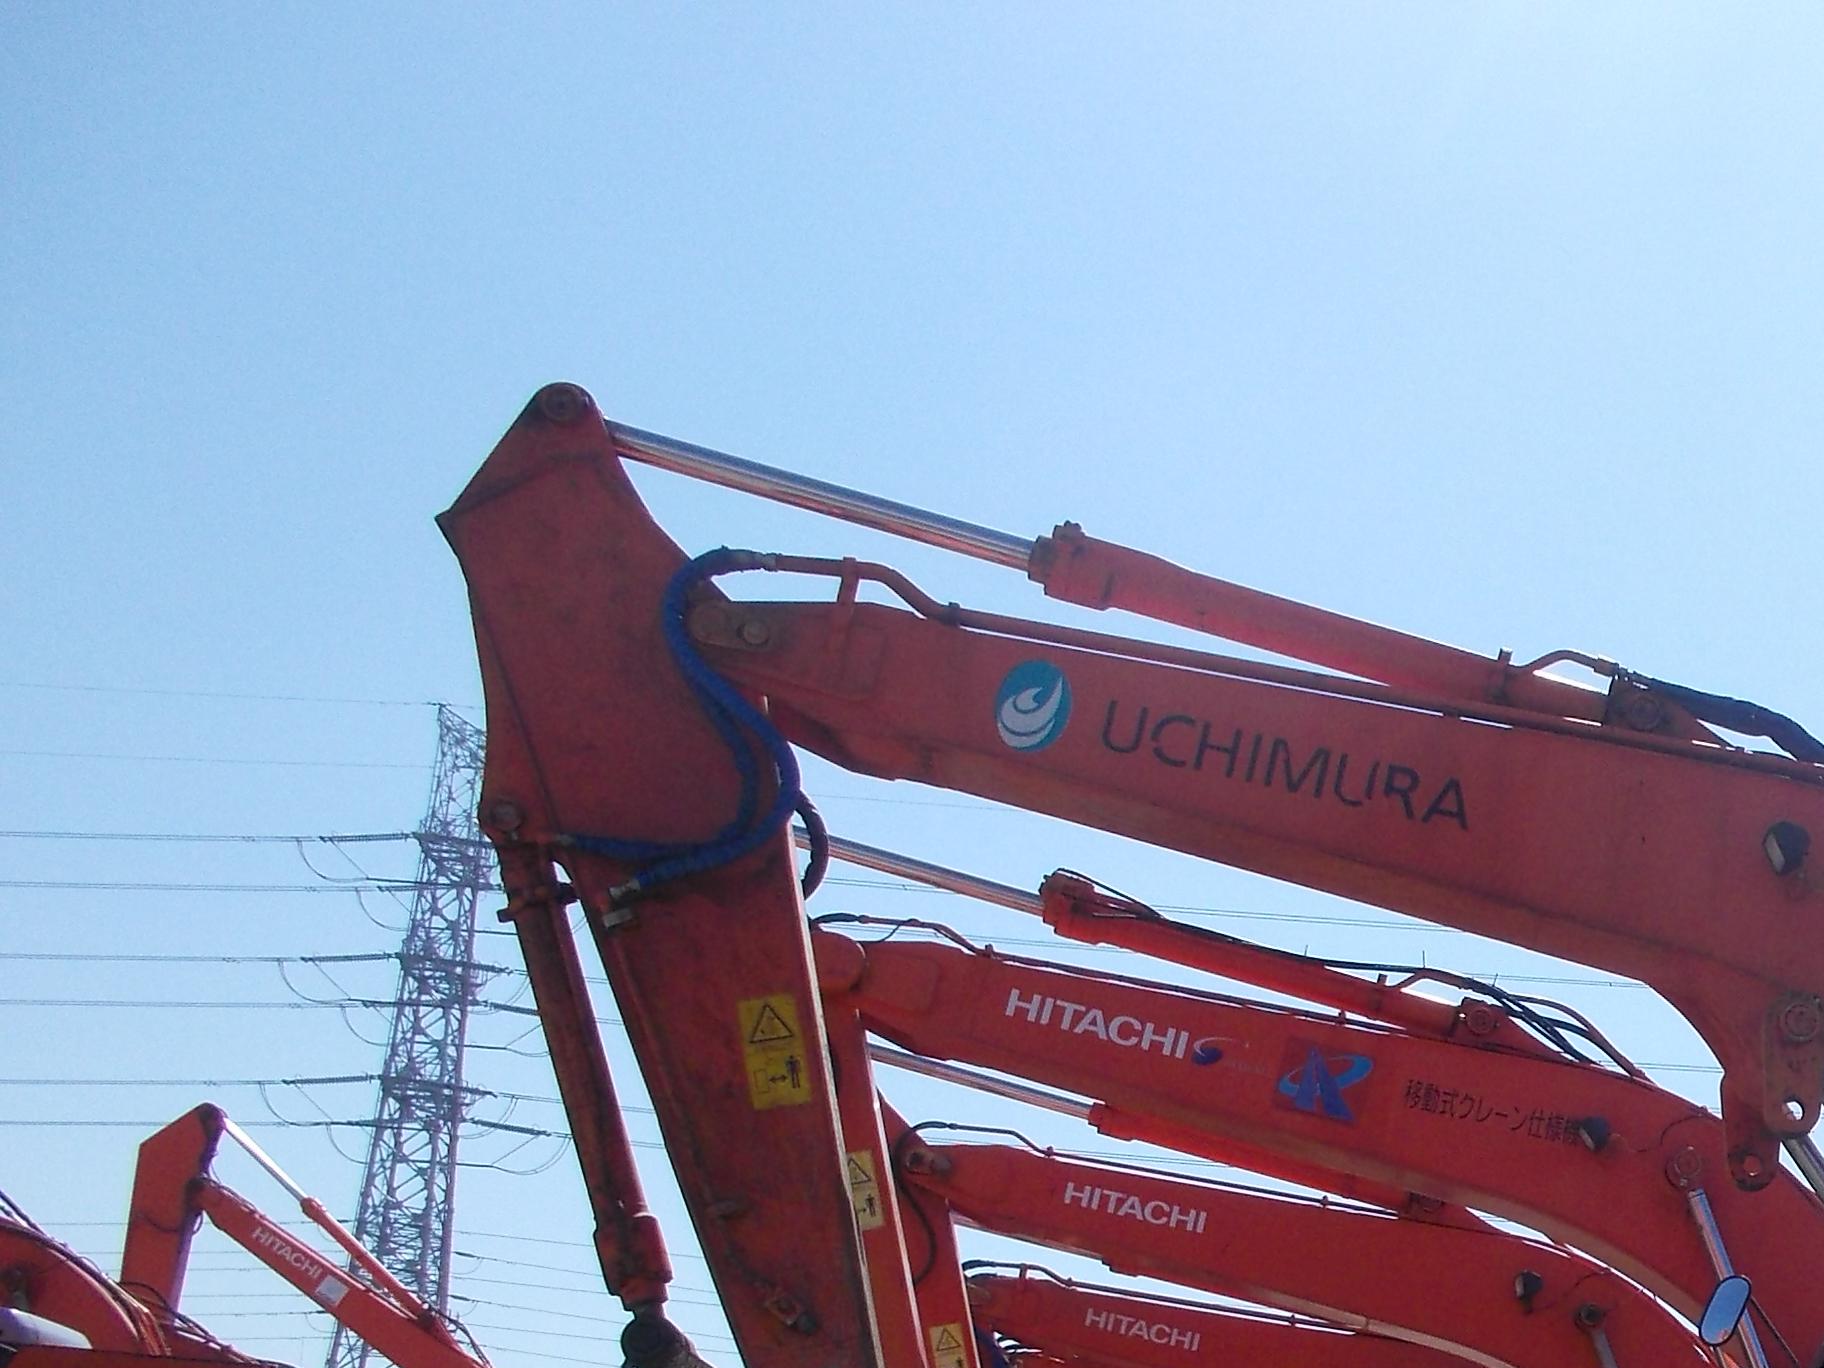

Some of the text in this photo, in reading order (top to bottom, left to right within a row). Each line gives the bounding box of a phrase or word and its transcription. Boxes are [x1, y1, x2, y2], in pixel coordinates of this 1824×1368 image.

[1102, 699, 1470, 830] UCHIMURA
[1004, 987, 1190, 1060] HITACHI
[1063, 1181, 1207, 1234] HITACHI
[252, 1226, 323, 1279] HITACHI
[1085, 1307, 1201, 1353] HITACHI
